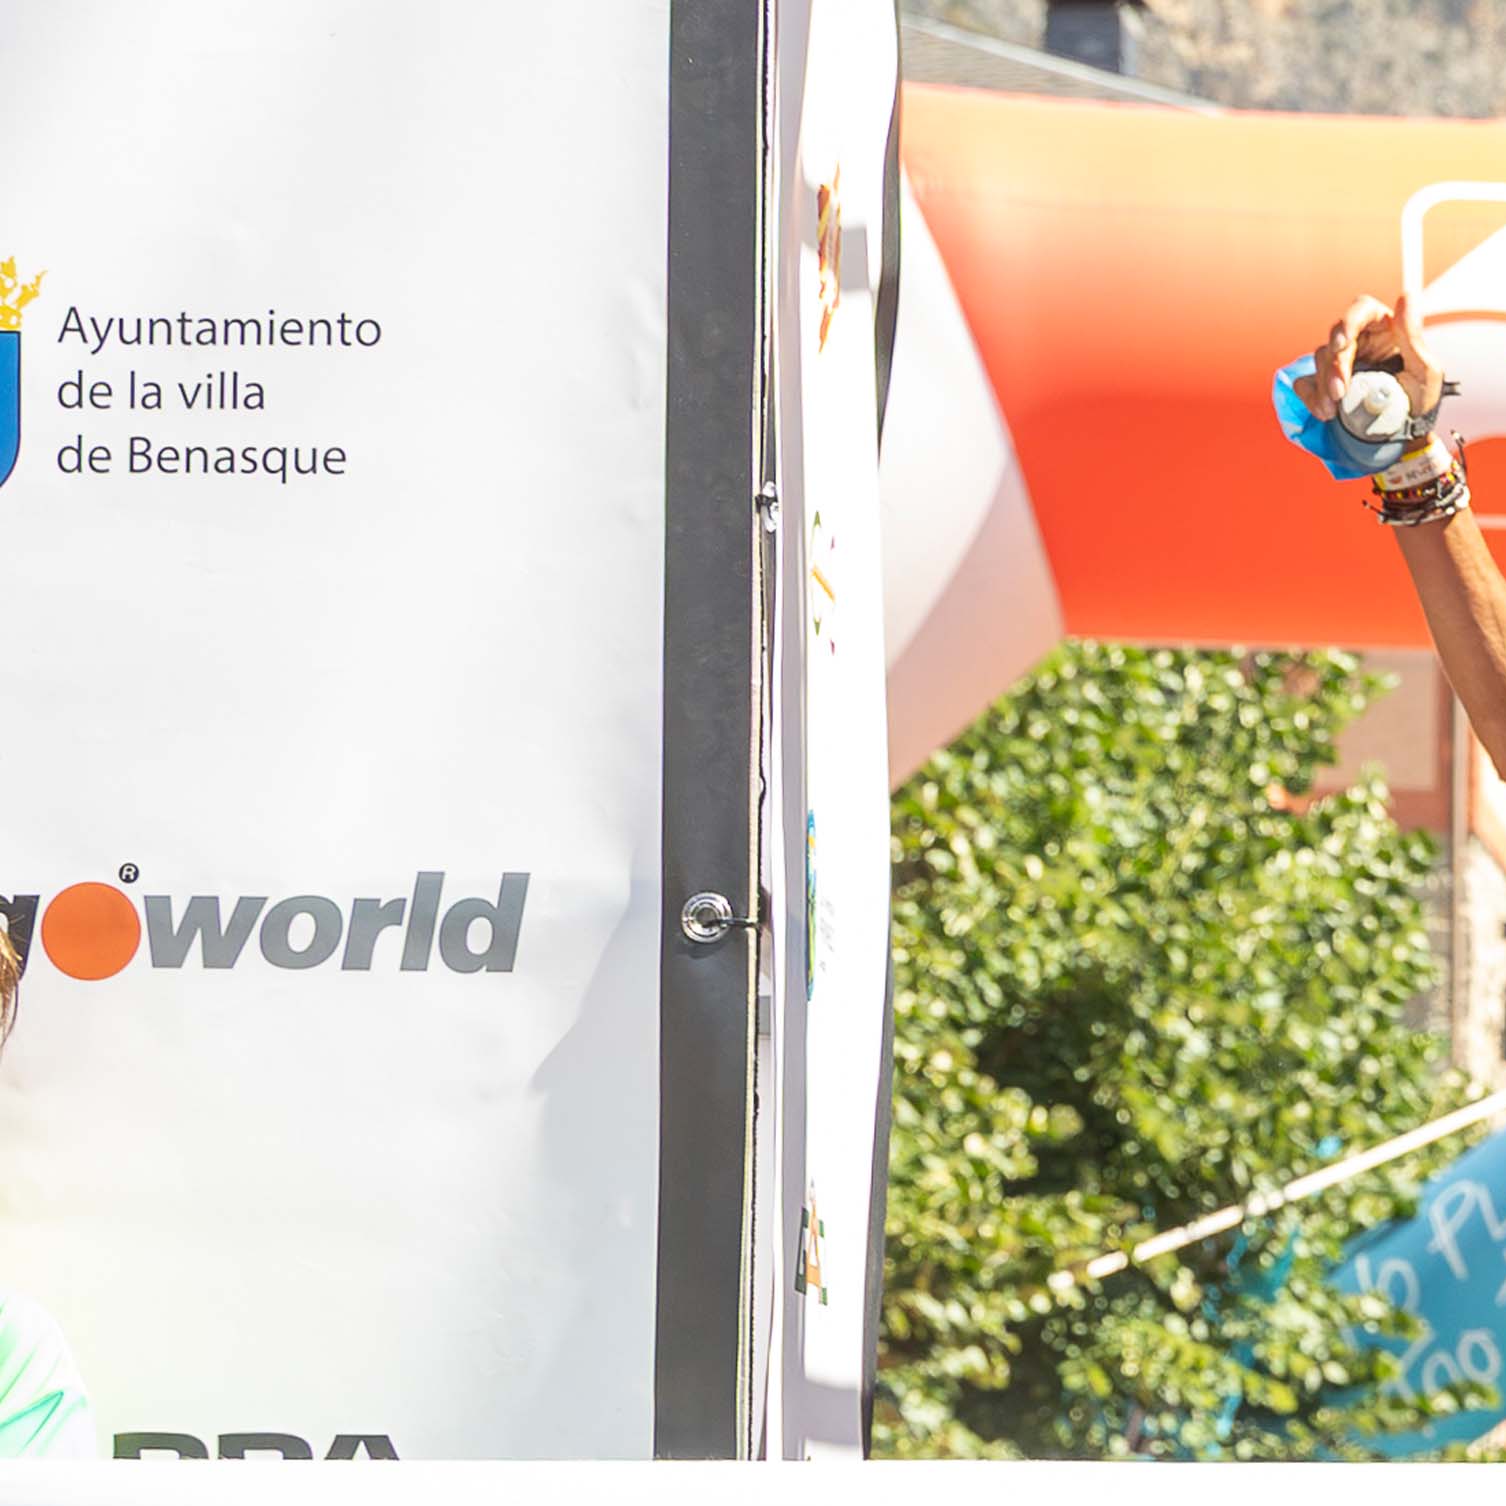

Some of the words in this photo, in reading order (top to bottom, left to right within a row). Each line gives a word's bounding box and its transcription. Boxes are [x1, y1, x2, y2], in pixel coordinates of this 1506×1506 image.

[57, 306, 383, 352] Ayuntamiento
[57, 371, 114, 411] de
[129, 371, 164, 411] la
[178, 372, 266, 411] villa
[57, 436, 113, 476] de
[129, 437, 348, 485] Benasque
